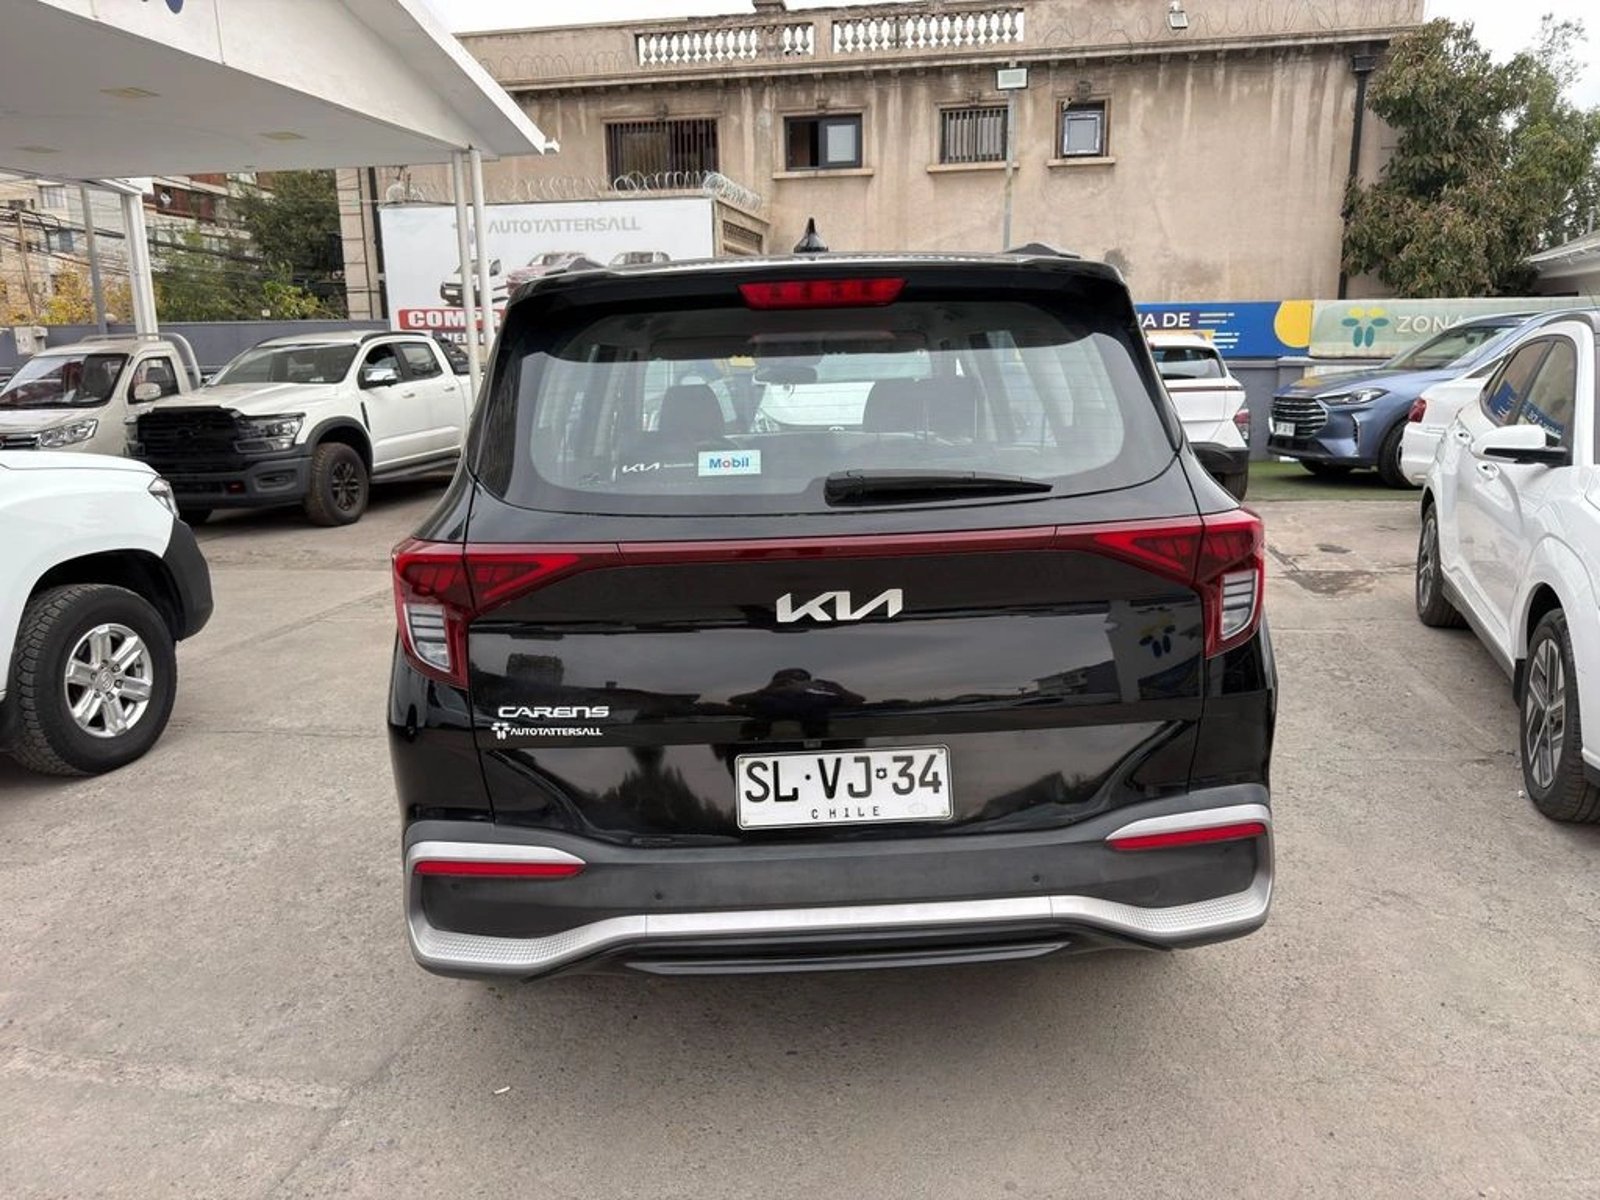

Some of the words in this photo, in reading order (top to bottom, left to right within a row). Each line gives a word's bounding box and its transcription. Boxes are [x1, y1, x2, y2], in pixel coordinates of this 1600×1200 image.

[488, 216, 643, 234] AUTOTATTERSALL
[1163, 312, 1191, 328] DE
[709, 457, 750, 469] Mobil
[776, 588, 903, 623] KIA
[498, 706, 609, 718] CARENS
[510, 727, 603, 736] AUTOTATTERSALL
[811, 806, 880, 820] CHILE
